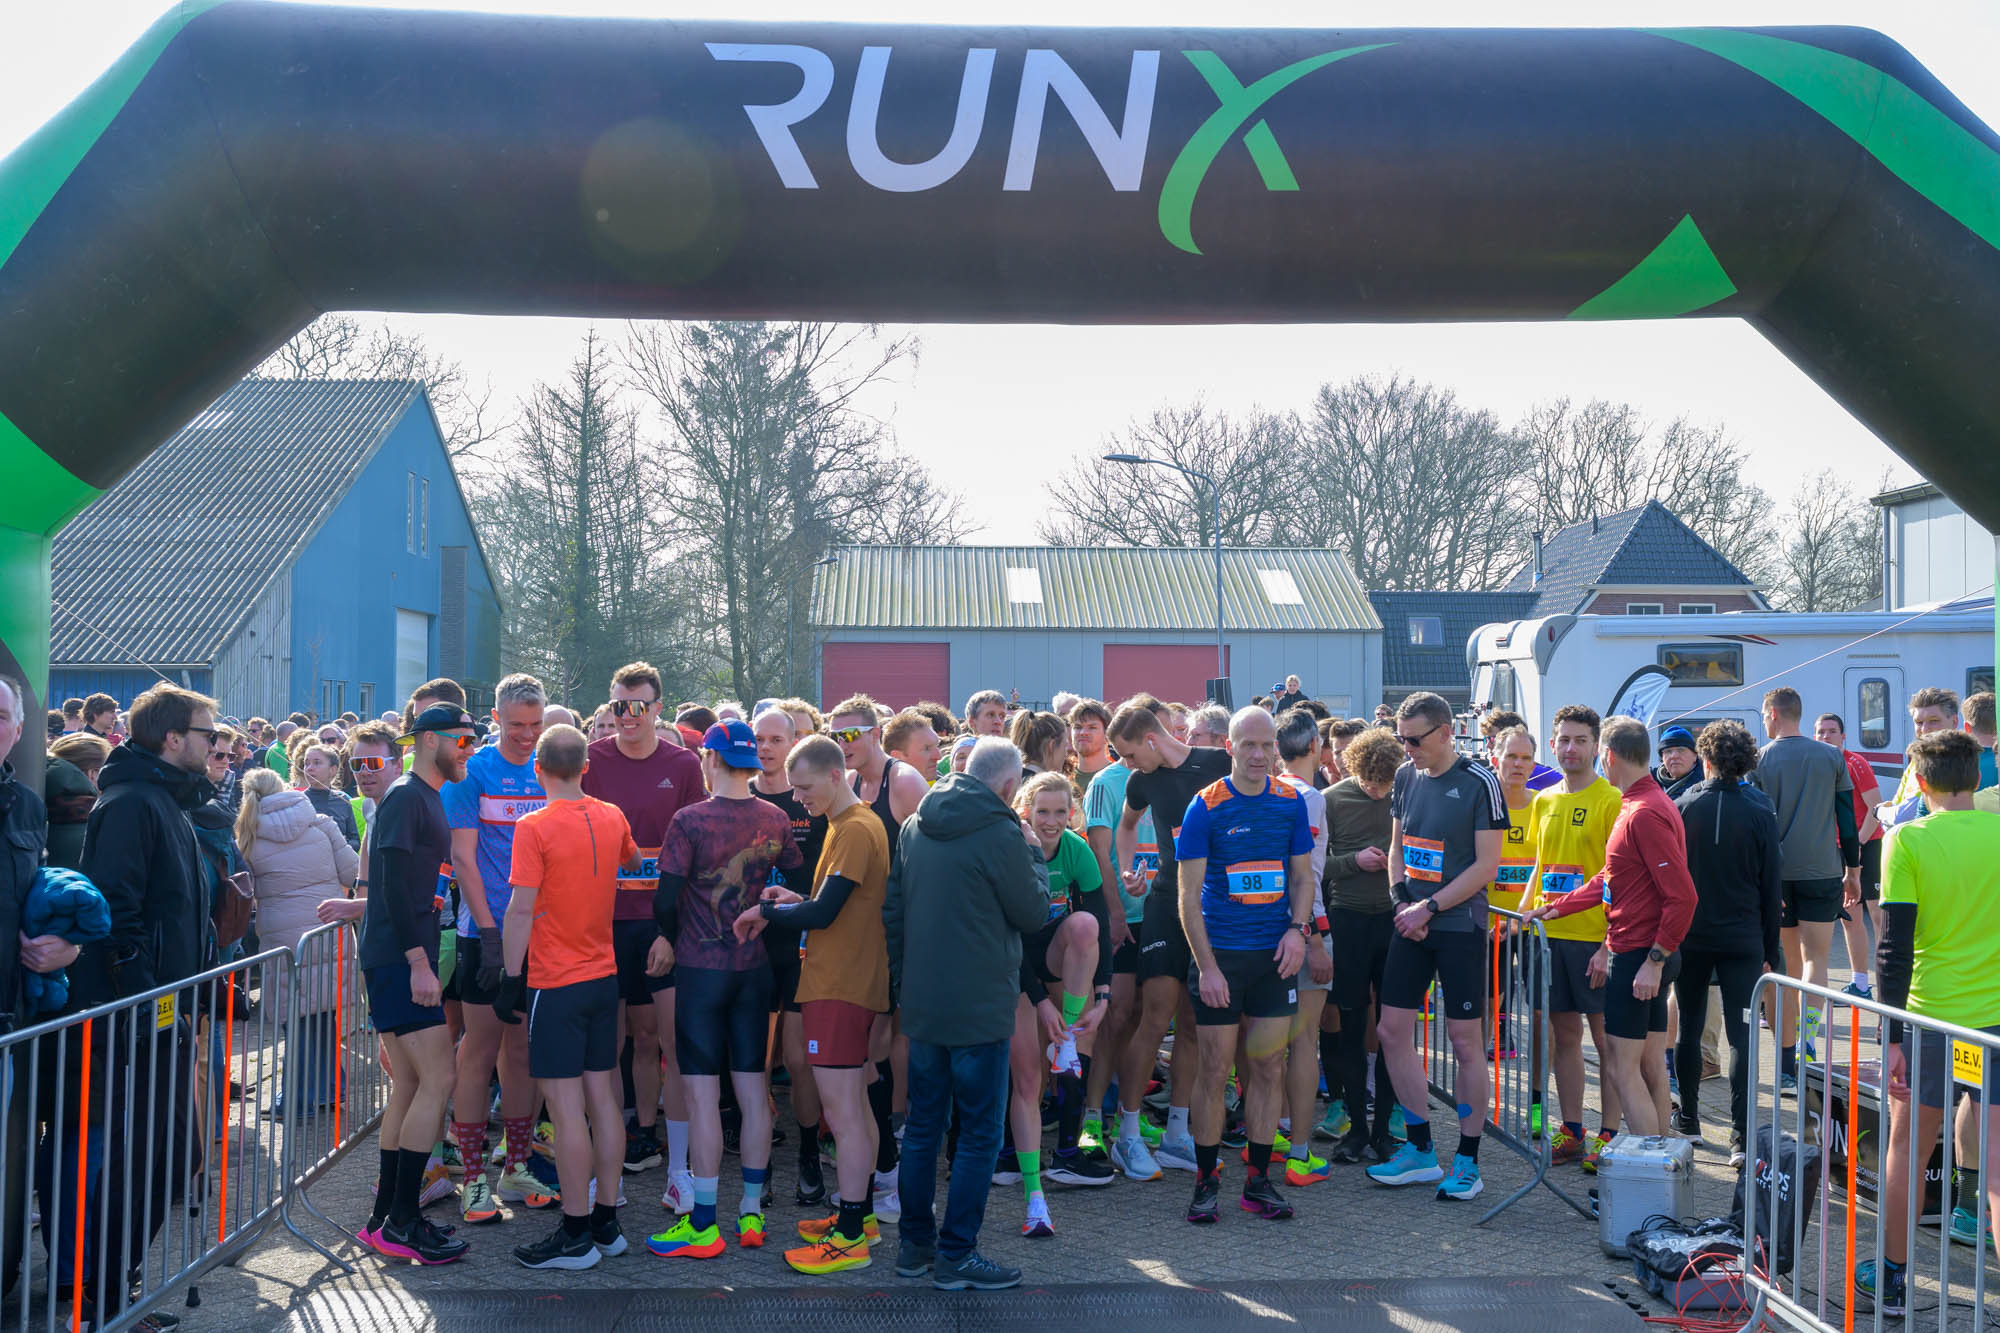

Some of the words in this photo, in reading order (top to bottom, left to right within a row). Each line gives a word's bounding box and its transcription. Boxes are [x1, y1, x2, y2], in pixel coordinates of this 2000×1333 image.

[703, 42, 1402, 255] RUNX
[1242, 874, 1262, 890] 98
[1954, 1047, 1981, 1069] D.E.V.
